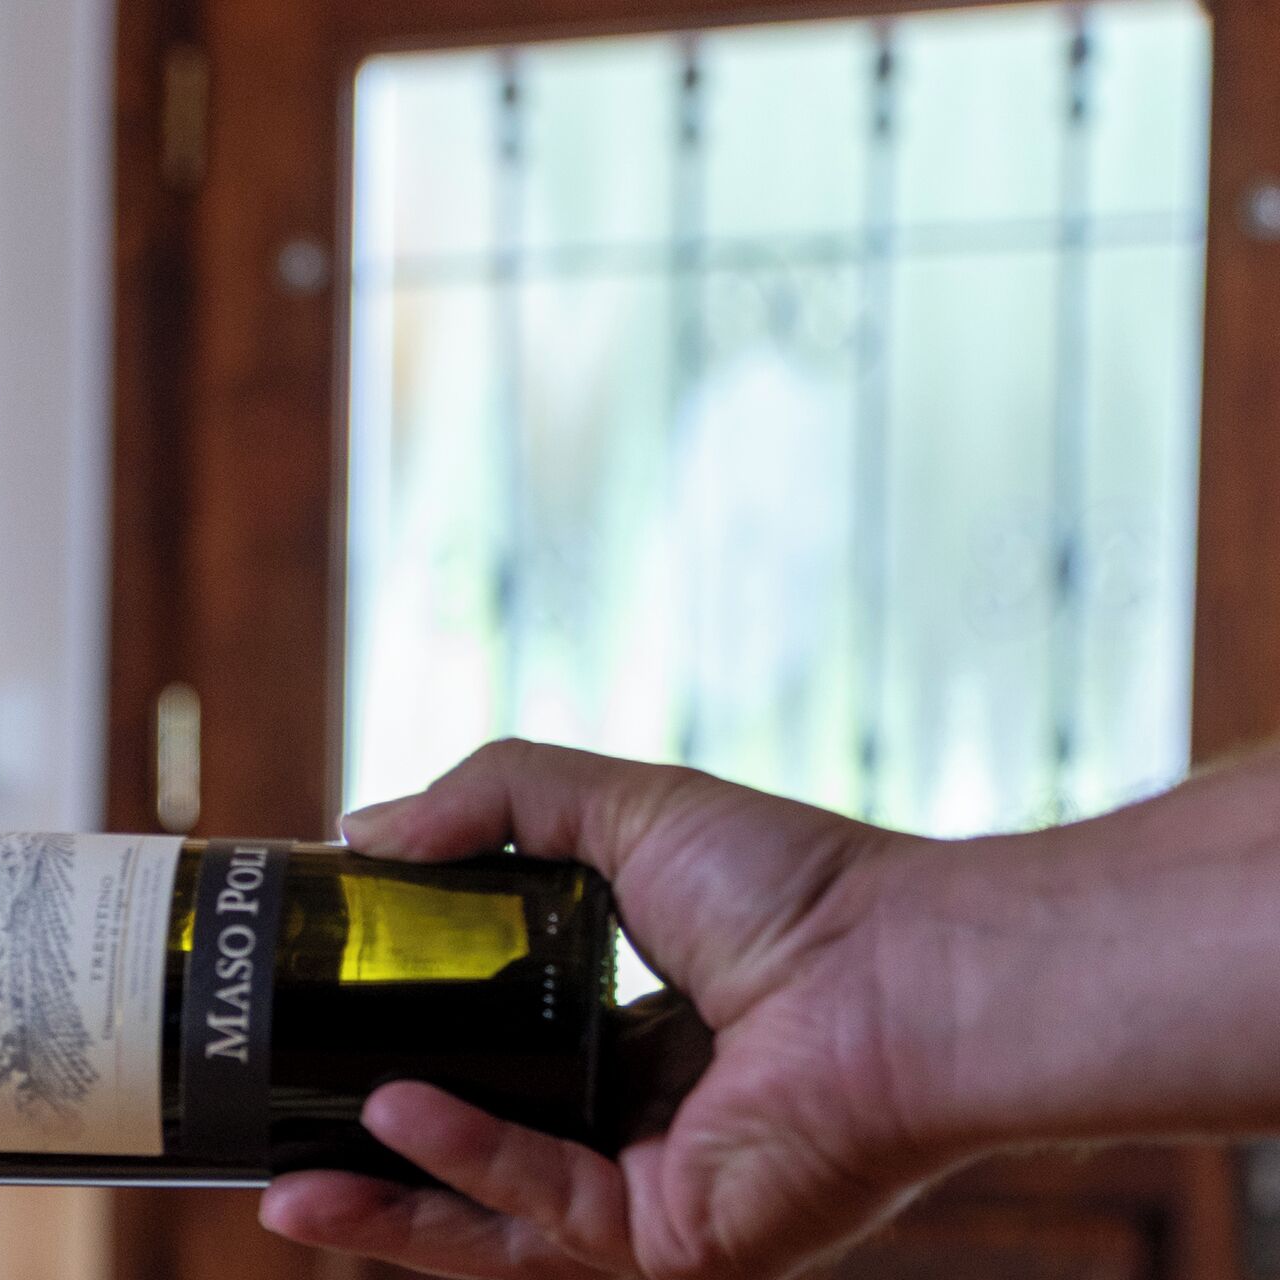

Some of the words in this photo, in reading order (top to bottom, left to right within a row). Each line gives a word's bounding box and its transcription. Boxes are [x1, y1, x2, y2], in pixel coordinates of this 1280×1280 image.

[90, 874, 113, 982] TRENTINO
[215, 846, 268, 917] POLI
[204, 923, 257, 1064] MASO
